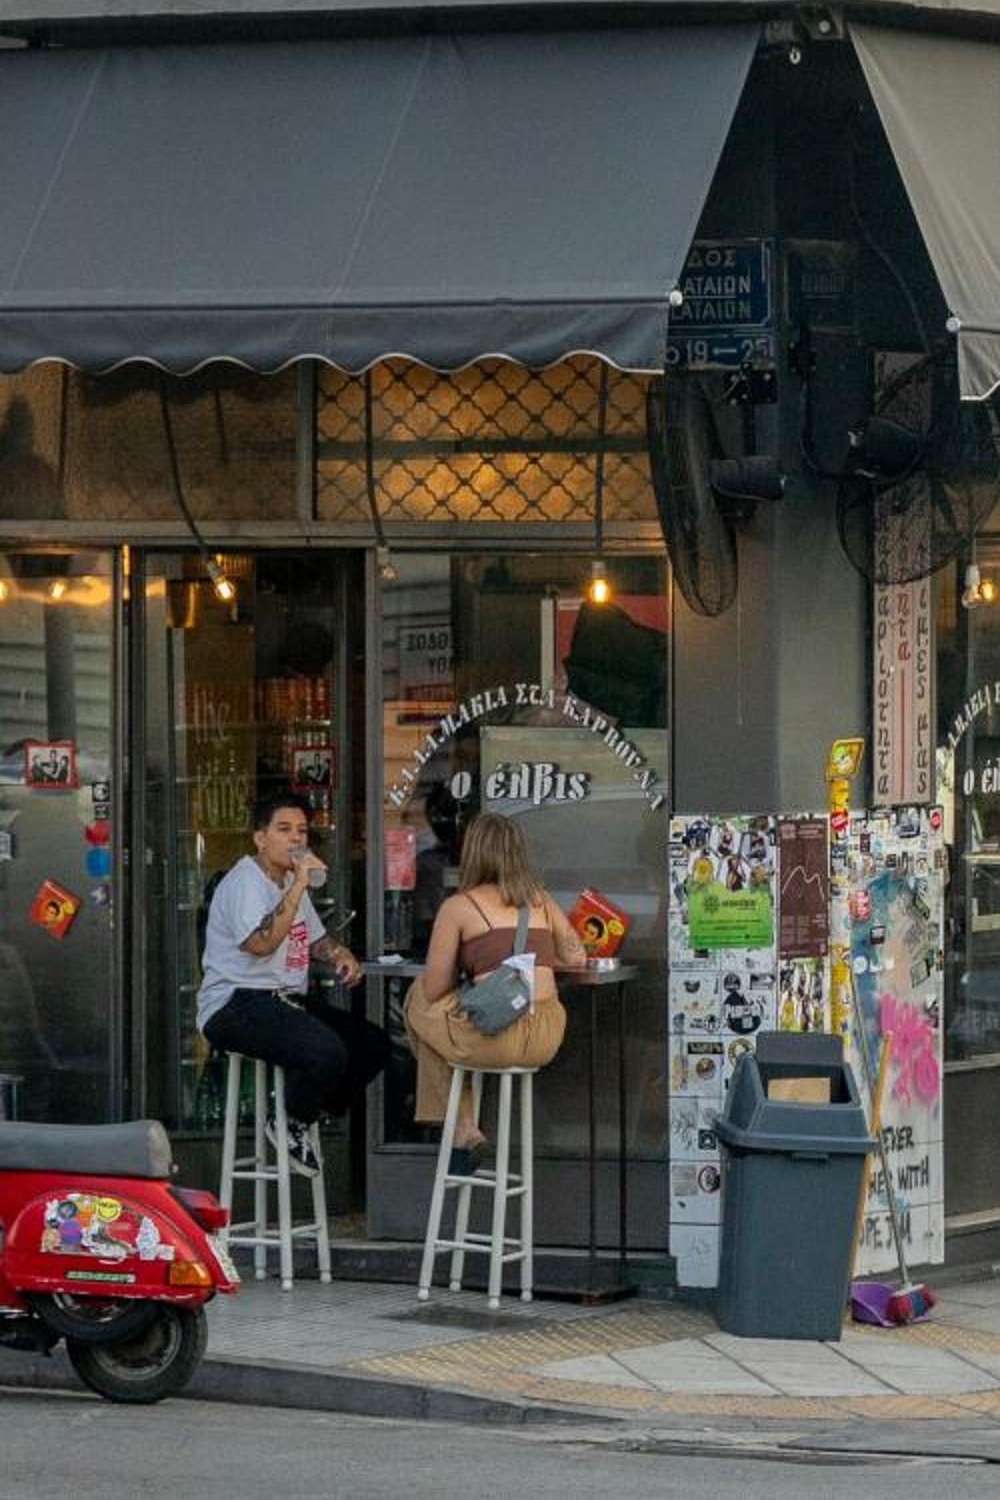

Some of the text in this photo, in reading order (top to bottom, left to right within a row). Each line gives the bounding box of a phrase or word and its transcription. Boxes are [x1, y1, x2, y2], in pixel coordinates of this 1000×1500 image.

[687, 249, 736, 267] ΔΟΣ
[671, 299, 752, 320] LATAION
[898, 1155, 930, 1191] WITH
